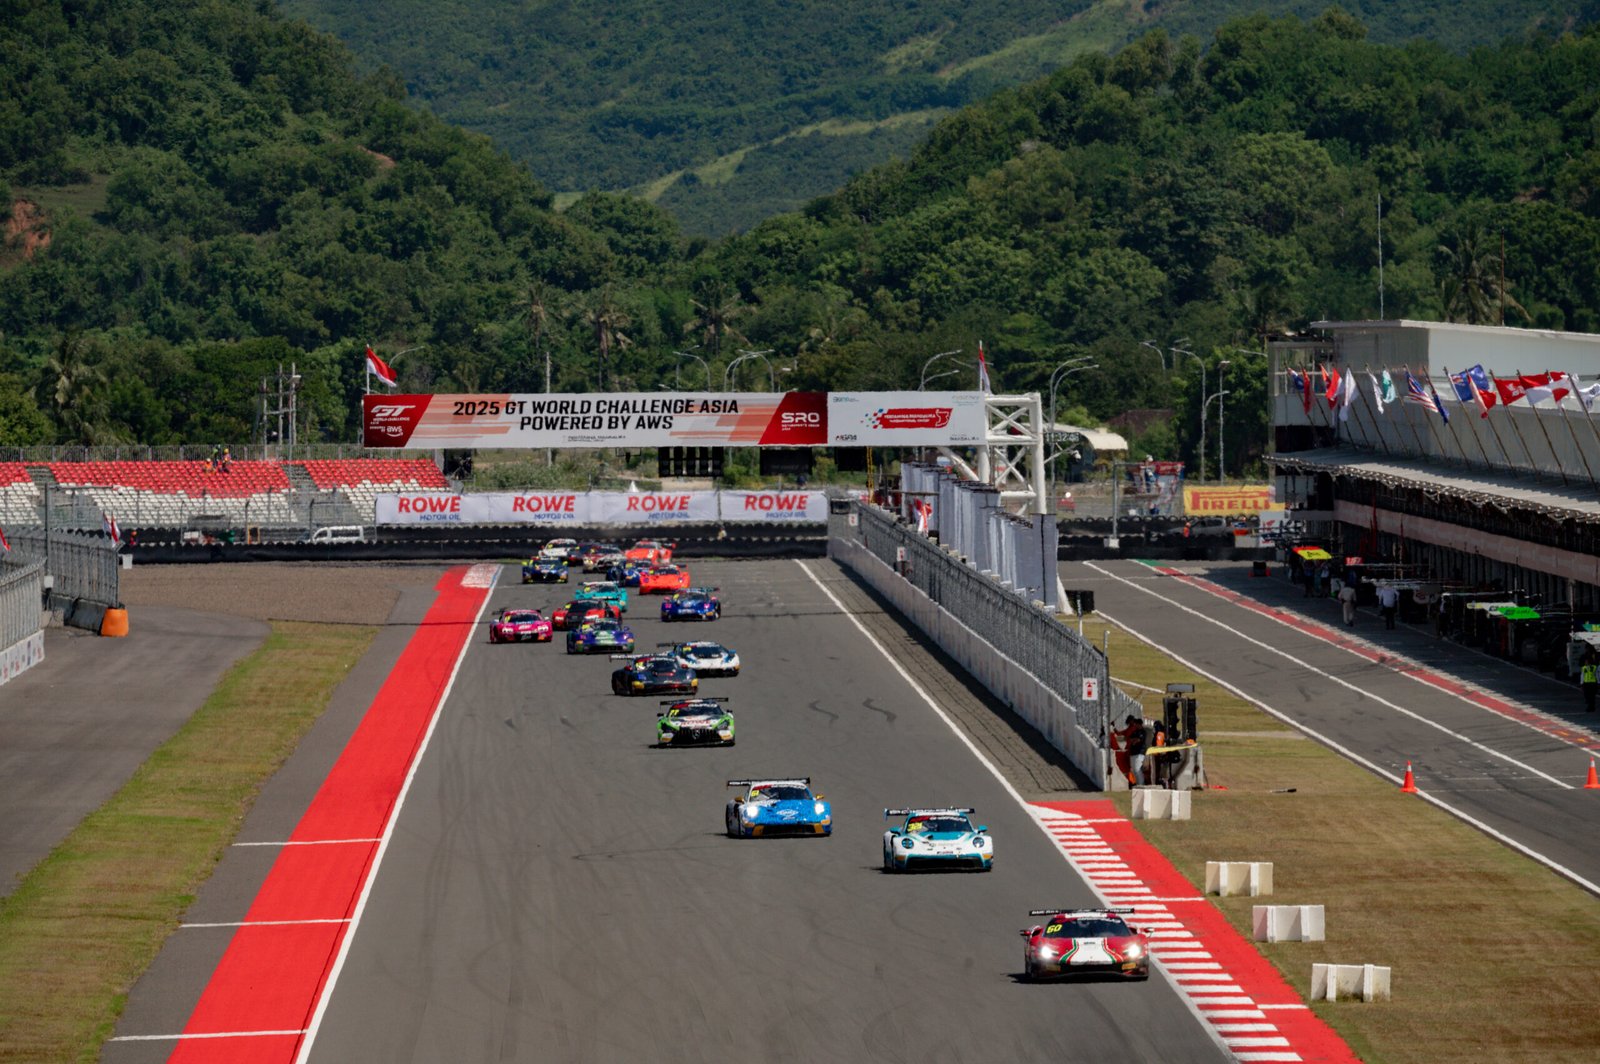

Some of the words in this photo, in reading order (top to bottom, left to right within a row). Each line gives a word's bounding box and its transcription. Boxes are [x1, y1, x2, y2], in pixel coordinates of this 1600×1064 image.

[371, 405, 416, 417] GT
[453, 401, 500, 416] 2025
[505, 401, 528, 415] GT
[532, 400, 591, 415] WORLD
[595, 399, 695, 414] CHALLENGE
[699, 399, 739, 413] ASIA
[520, 416, 603, 431] POWERED
[607, 416, 632, 430] BY
[635, 415, 674, 430] AWS
[781, 412, 820, 423] SRO
[398, 495, 461, 513] ROWE
[513, 495, 576, 513] ROWE
[627, 495, 690, 512] ROWE
[744, 494, 808, 511] ROWE
[1191, 490, 1271, 510] PIRELLI
[419, 513, 447, 522] MOTOR
[1046, 924, 1063, 934] 60
